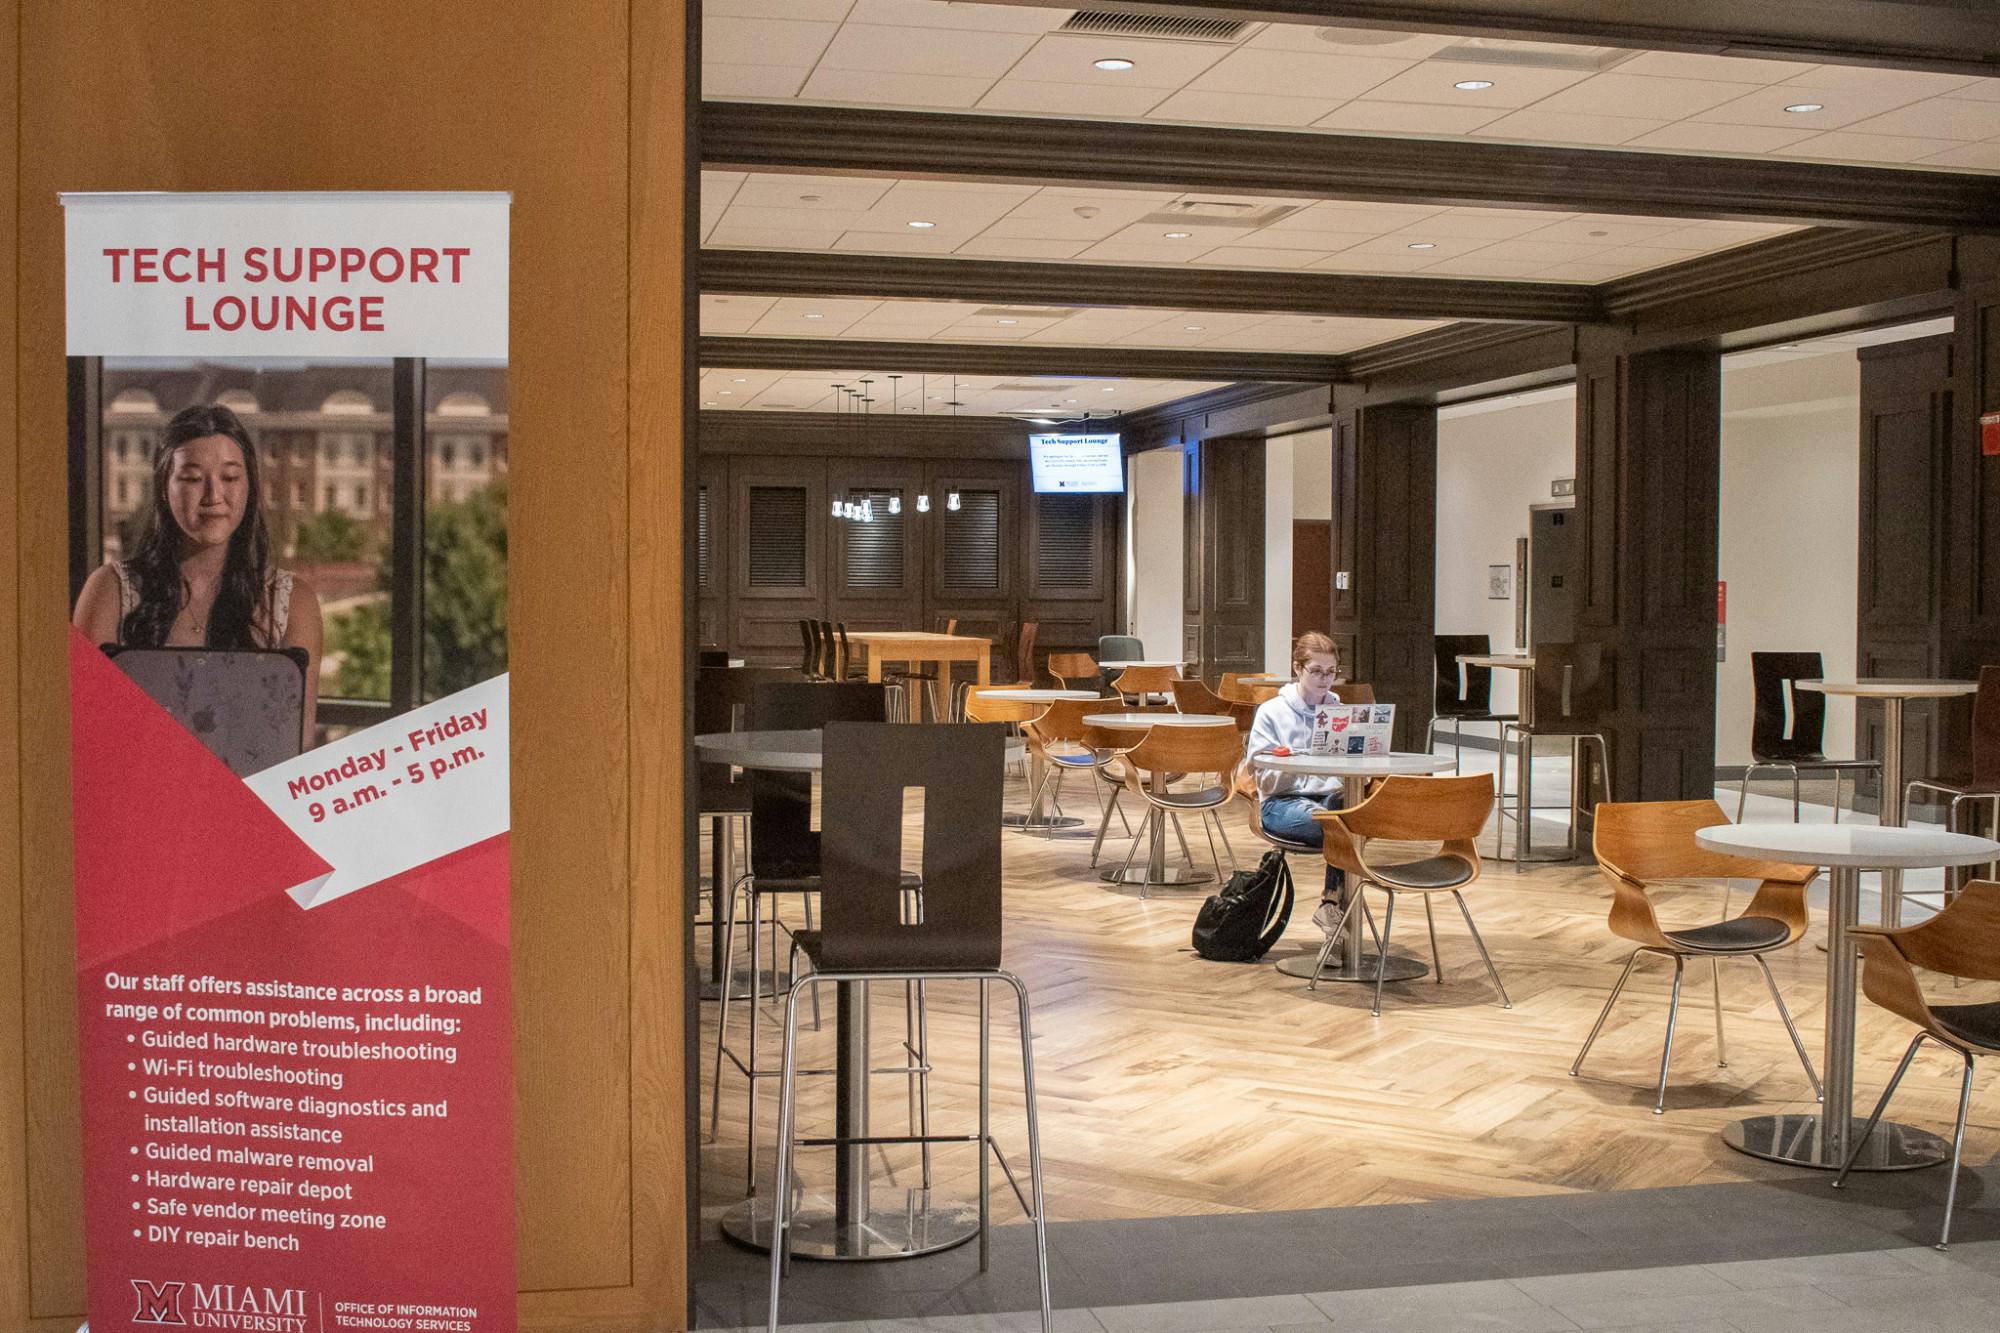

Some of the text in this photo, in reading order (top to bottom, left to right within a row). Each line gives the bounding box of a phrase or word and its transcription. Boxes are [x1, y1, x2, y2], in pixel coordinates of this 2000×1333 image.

[102, 246, 471, 284] TECH SUPPORT
[184, 295, 385, 332] LOUNGE
[287, 748, 387, 800] Monday
[407, 707, 488, 753] Friday
[308, 801, 326, 823] 9
[332, 784, 387, 815] a.m.
[407, 762, 424, 784] 5
[429, 745, 485, 780] p.m.
[105, 971, 482, 1005] Our staff offers assistance across a broad
[105, 1002, 462, 1035] range of common problems, including:
[142, 1030, 457, 1063] Guided hardware troubleshooting
[143, 1058, 344, 1090] Wi-Fi troubleshooting
[143, 1086, 448, 1118] Guided software diagnostics and
[144, 1114, 343, 1144] installation assistance
[145, 1142, 374, 1173] Guided malware removal
[147, 1170, 353, 1202] Hardware repair depot
[147, 1198, 387, 1229] Safe vendor meeting zone
[149, 1224, 300, 1252] DIY repair bench
[192, 1282, 308, 1316] MIAMI
[334, 1301, 478, 1319] OFFICE OF INFORMATION
[192, 1312, 308, 1333] UNIVERSITY
[335, 1315, 472, 1332] TECHNOLOGY SERVICES
